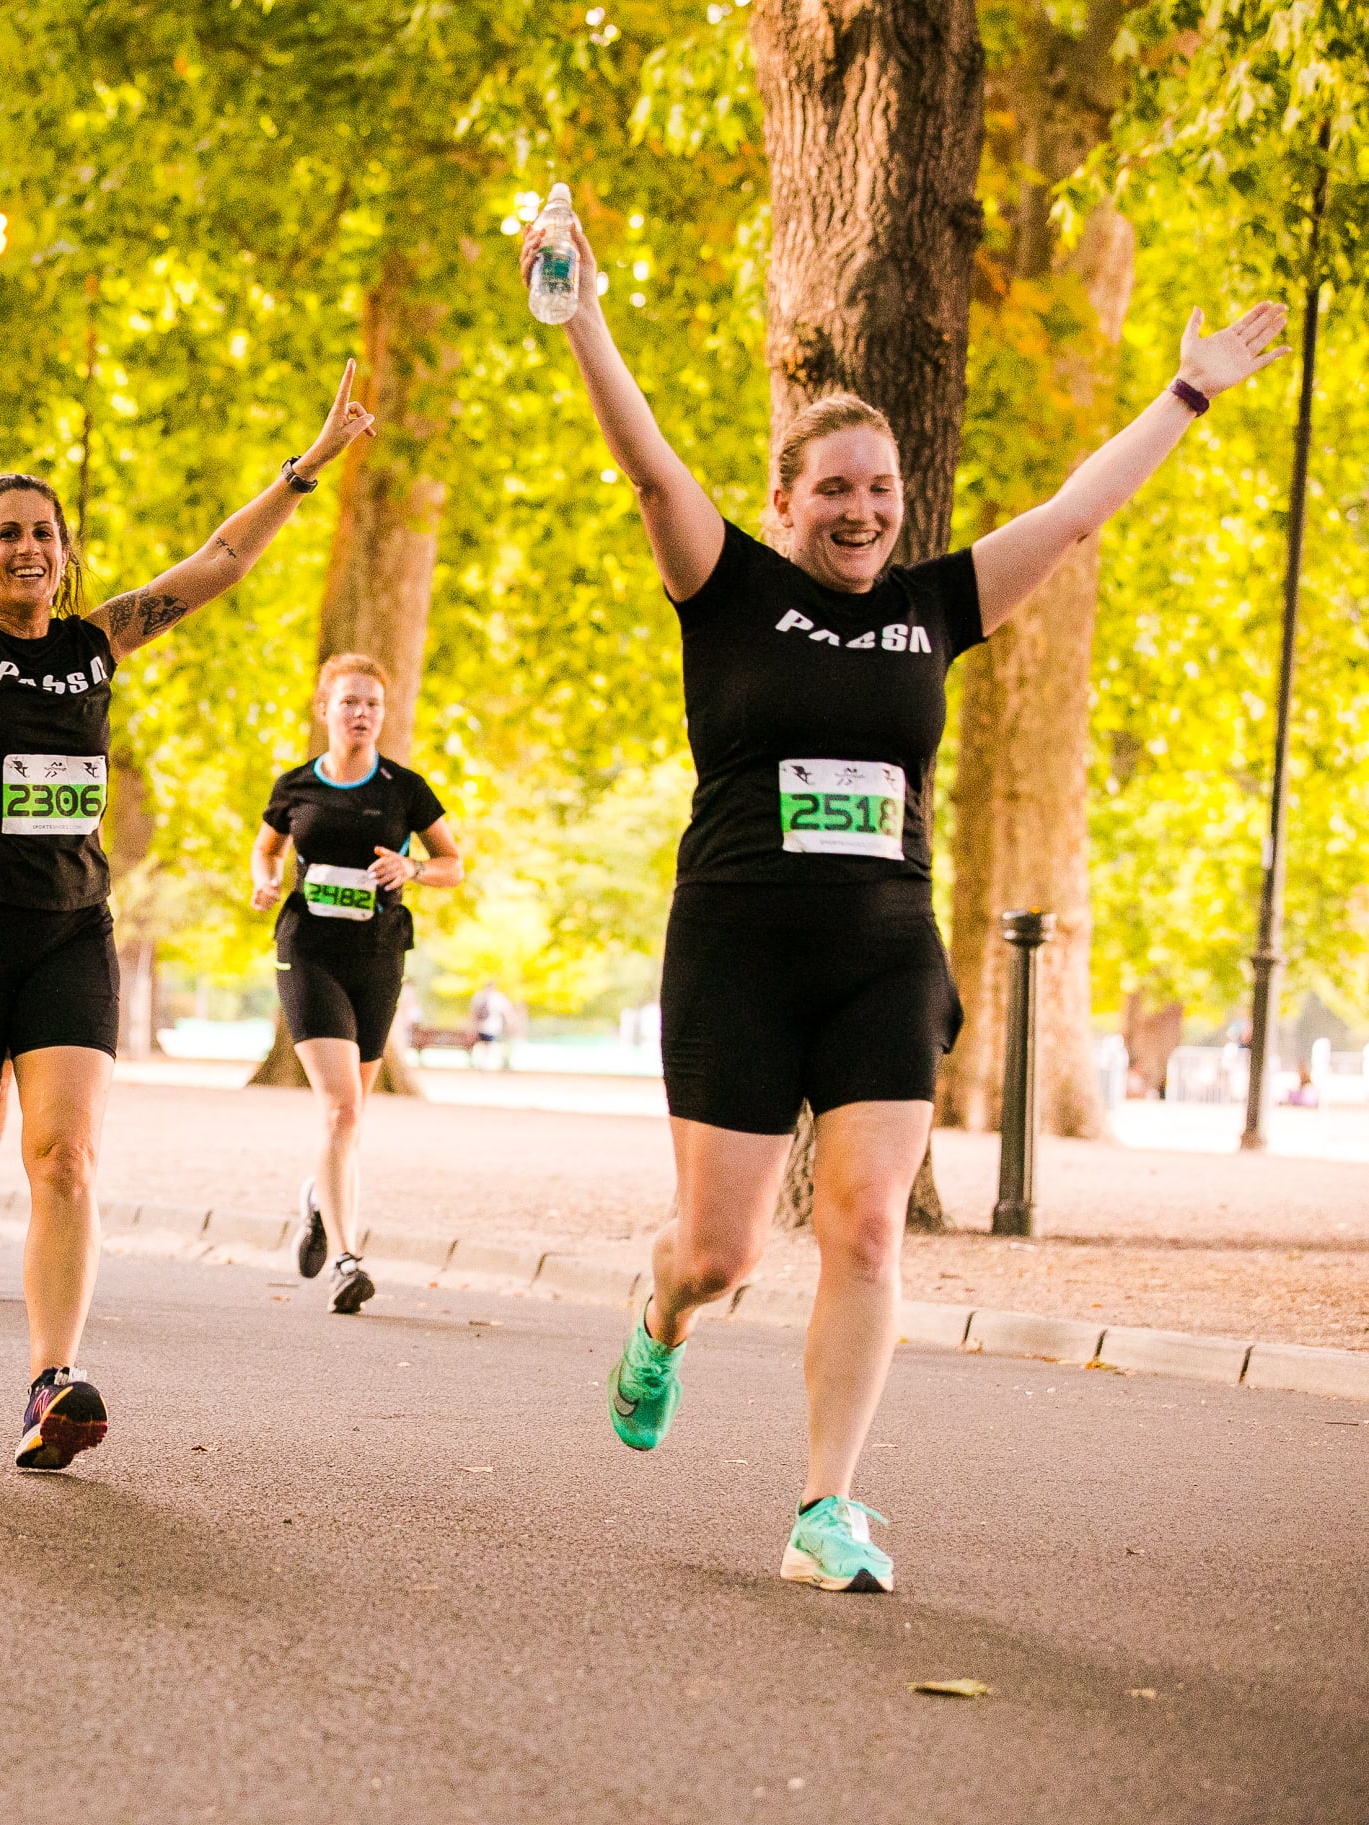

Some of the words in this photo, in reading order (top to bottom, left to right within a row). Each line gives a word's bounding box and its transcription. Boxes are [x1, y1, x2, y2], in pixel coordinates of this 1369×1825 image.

[7, 784, 102, 817] 2306
[790, 793, 897, 836] 2518
[309, 883, 371, 910] 2482
